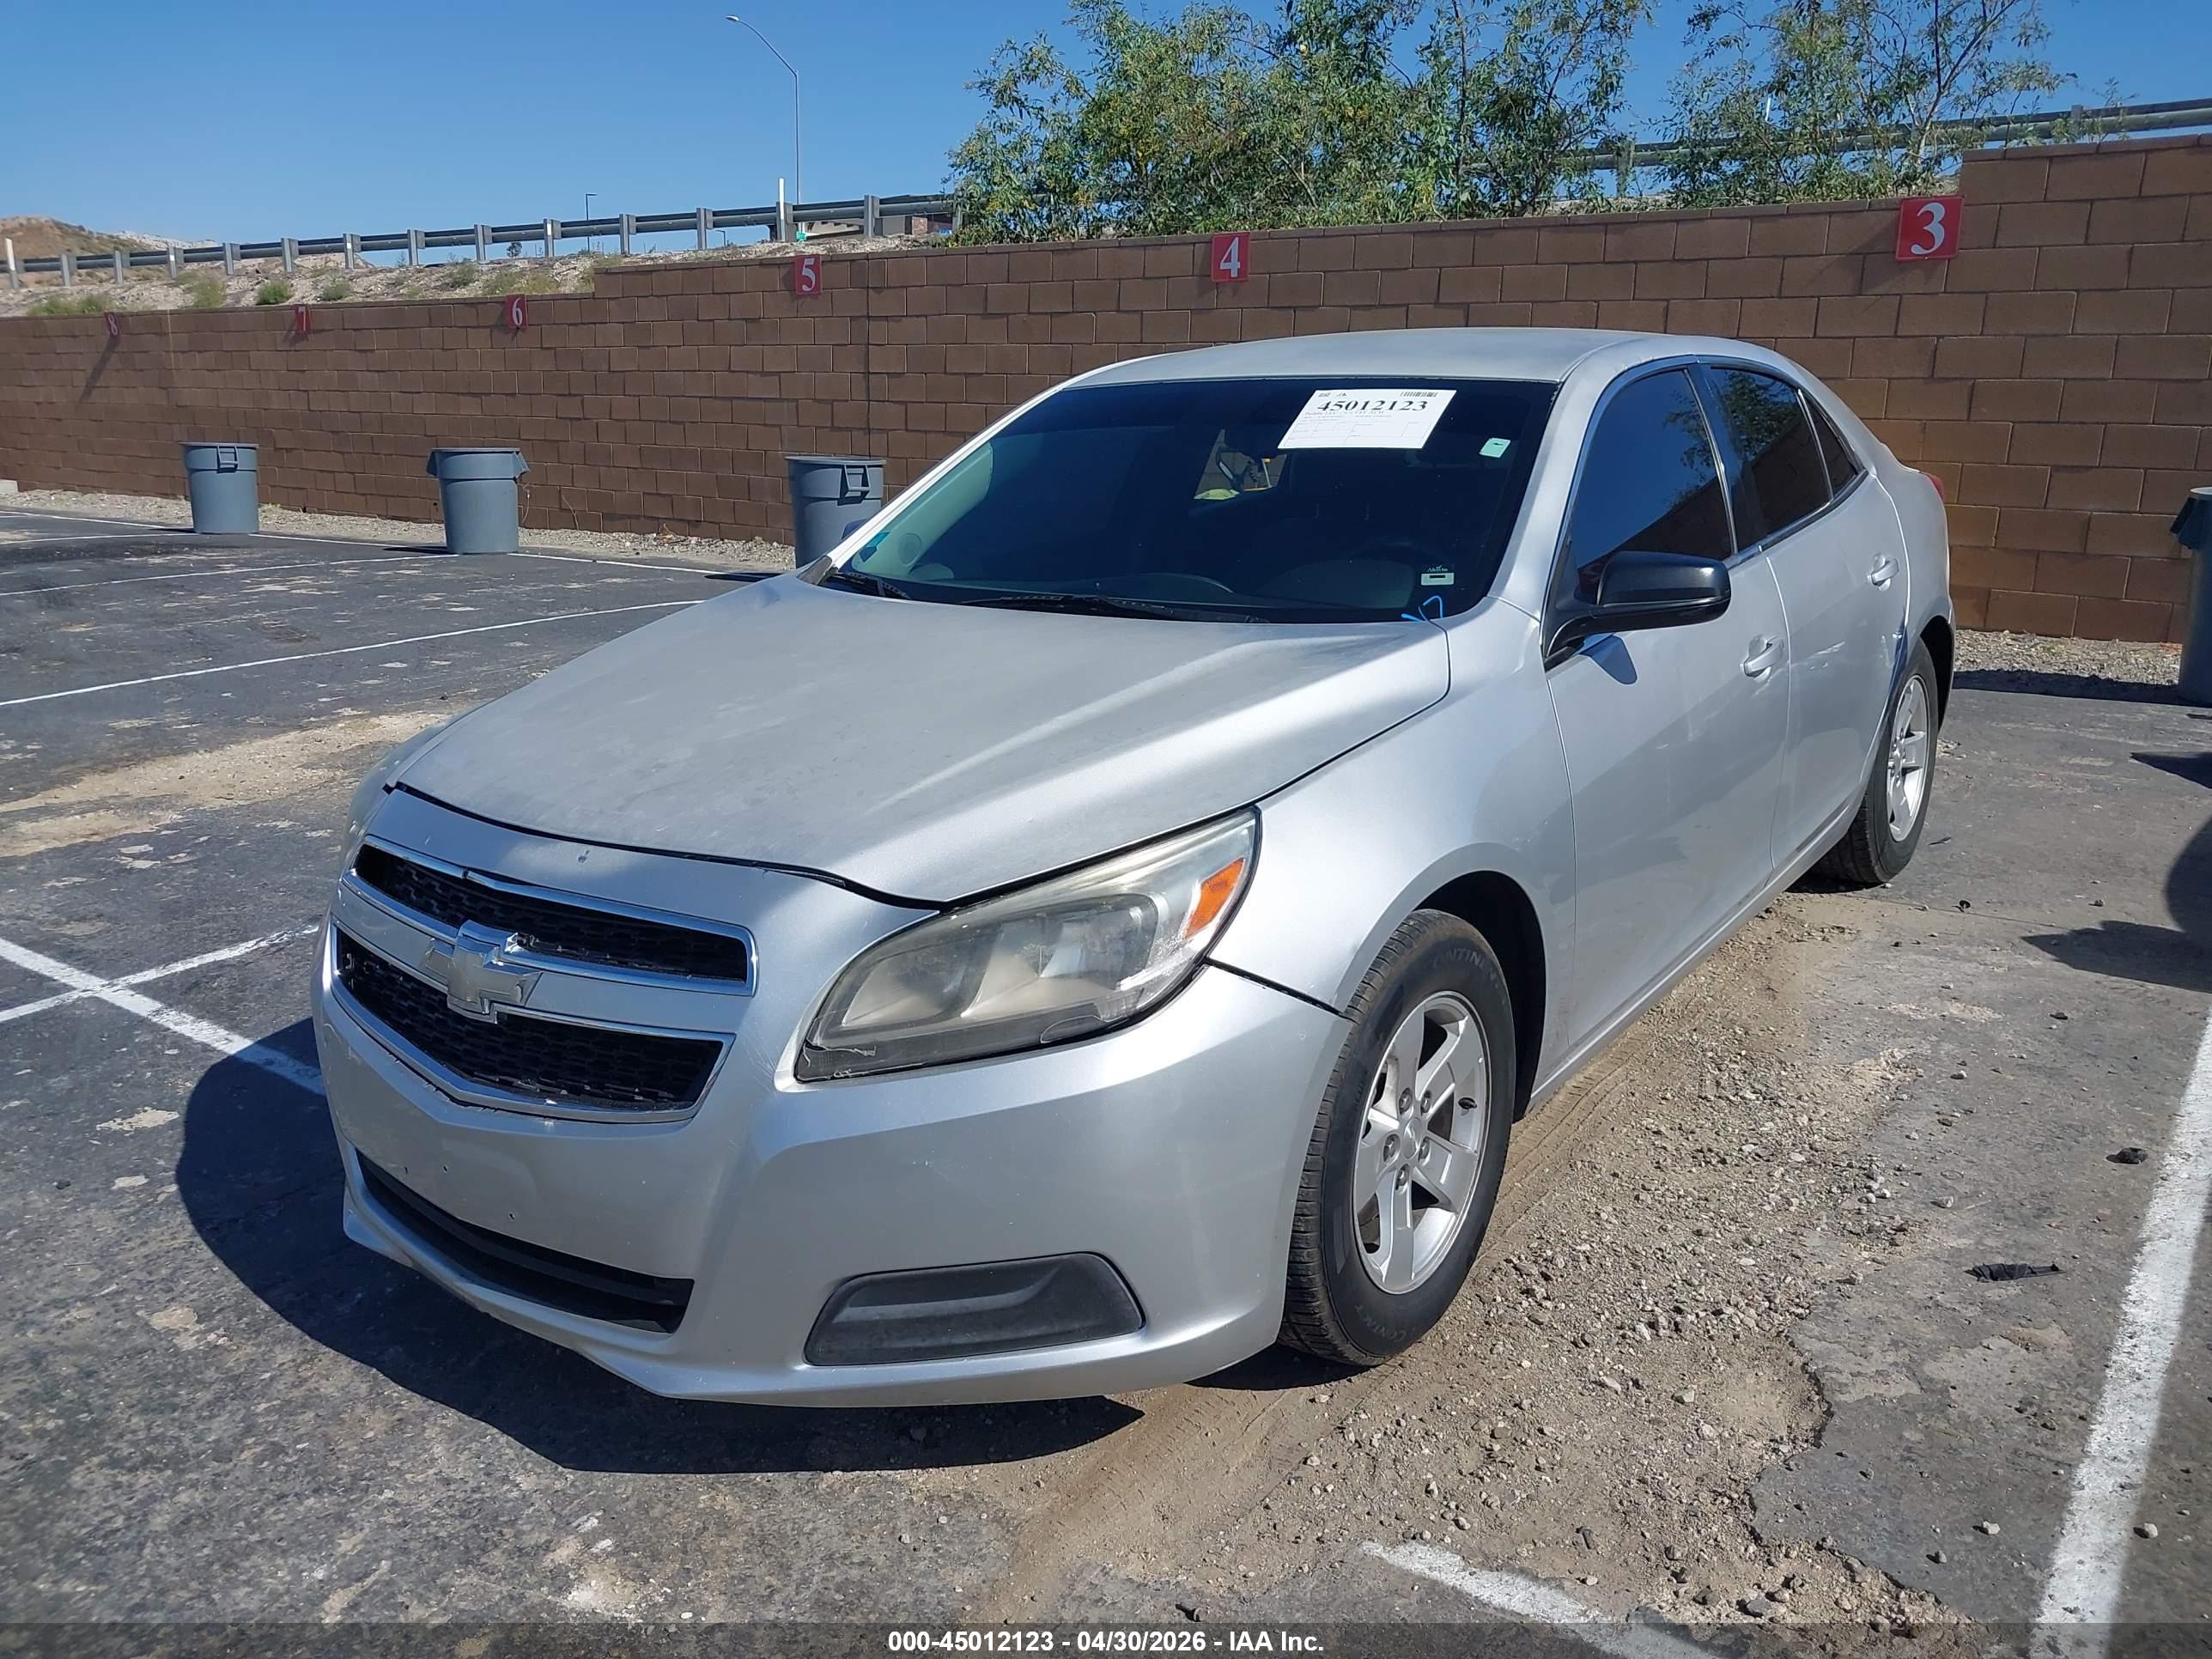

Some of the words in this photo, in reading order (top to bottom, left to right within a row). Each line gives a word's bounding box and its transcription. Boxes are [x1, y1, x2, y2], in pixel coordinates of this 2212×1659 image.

[1911, 202, 1946, 254] 3
[1219, 236, 1241, 278] 4
[801, 258, 816, 291] 5
[108, 315, 118, 336] 8
[298, 306, 307, 331] 7
[512, 296, 523, 326] 6
[1317, 399, 1428, 411] 45012123
